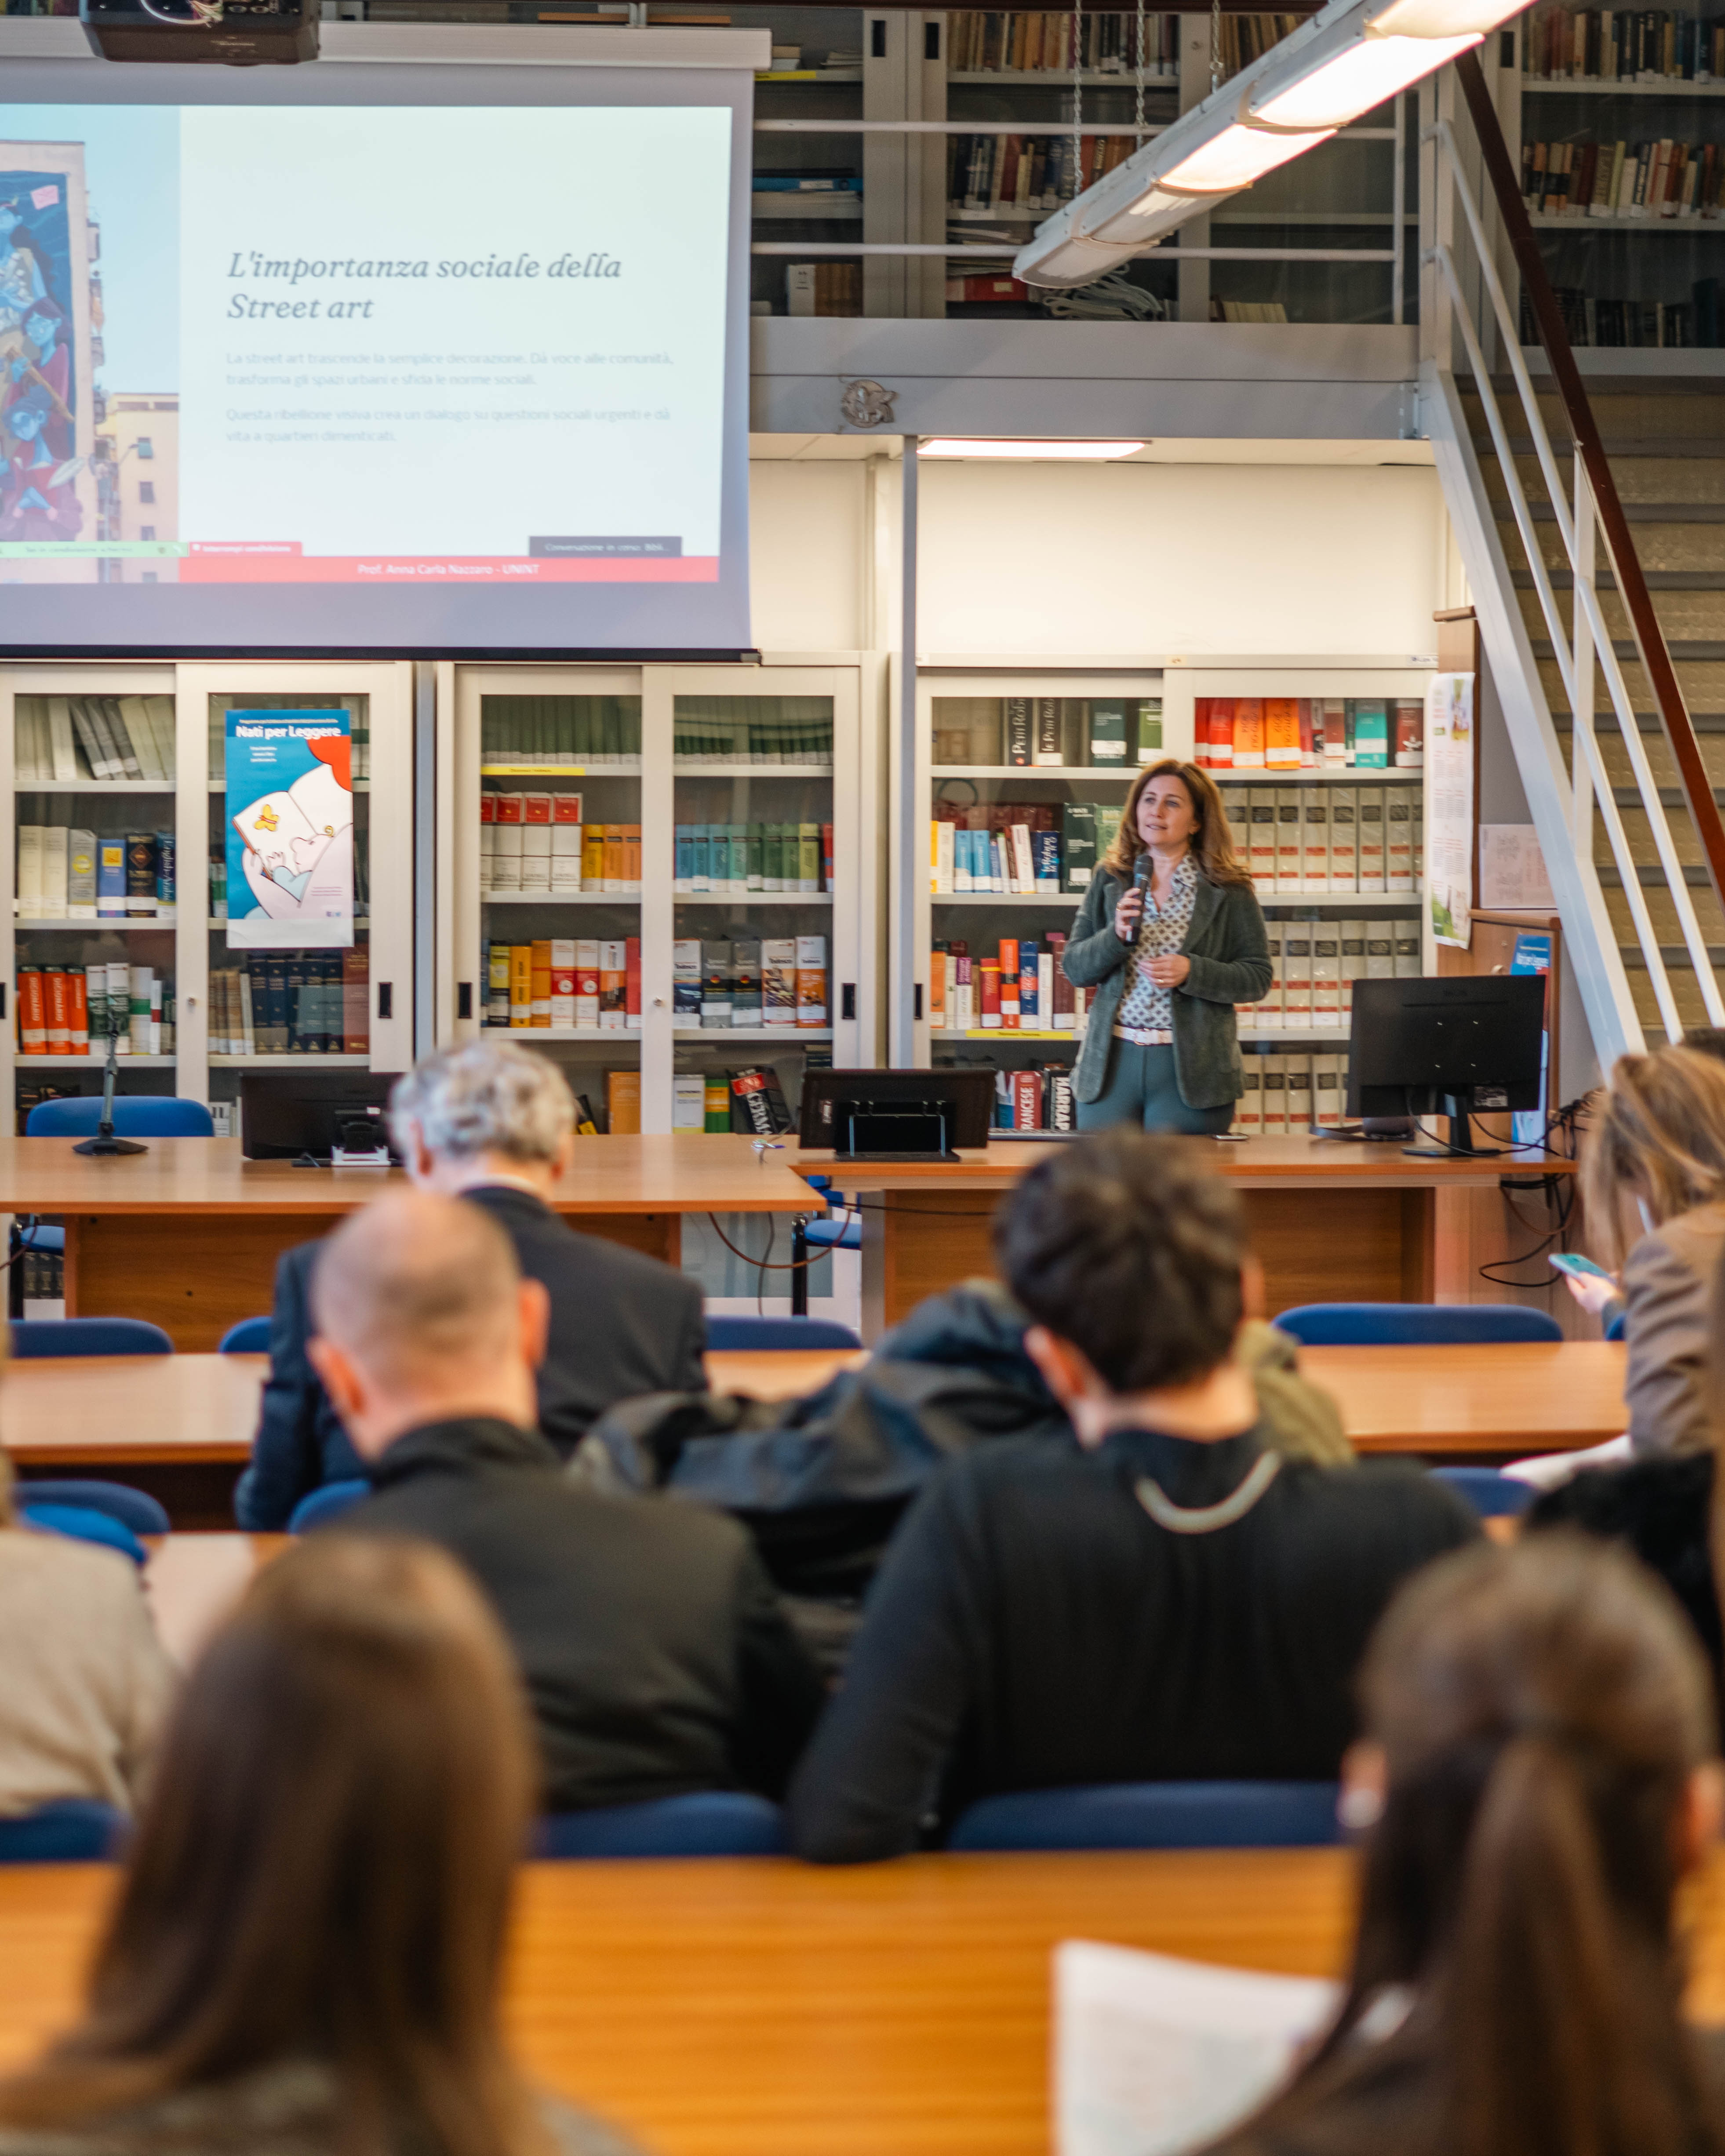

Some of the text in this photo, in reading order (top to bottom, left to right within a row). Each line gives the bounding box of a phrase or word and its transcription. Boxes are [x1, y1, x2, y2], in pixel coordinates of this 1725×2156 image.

[228, 251, 622, 285] L'importanza sociale della
[227, 294, 374, 319] Street art
[227, 352, 674, 366] La street art trascende la semplice decorazione. Dà voce alle comunità,
[226, 374, 291, 385] trasforma
[295, 374, 308, 388] gli
[312, 375, 343, 388] spazi
[347, 374, 387, 385] urbani
[401, 374, 433, 385] sfida
[436, 374, 446, 385] le
[450, 377, 491, 385] norme
[495, 374, 536, 385] sociali.
[226, 408, 670, 423] Questa ribellione visiva crea un dialogo su questioni sociali urgenti e dà
[226, 431, 397, 444] vita a quartieri dimenticati.
[358, 564, 382, 574] Prof.
[386, 564, 415, 574] Anna
[417, 564, 447, 574] Carla
[448, 564, 493, 574] Nazzaro
[502, 564, 539, 574] UNINT
[236, 725, 342, 740] Nati per Leggere
[1020, 1087, 1034, 1130] RANCESE
